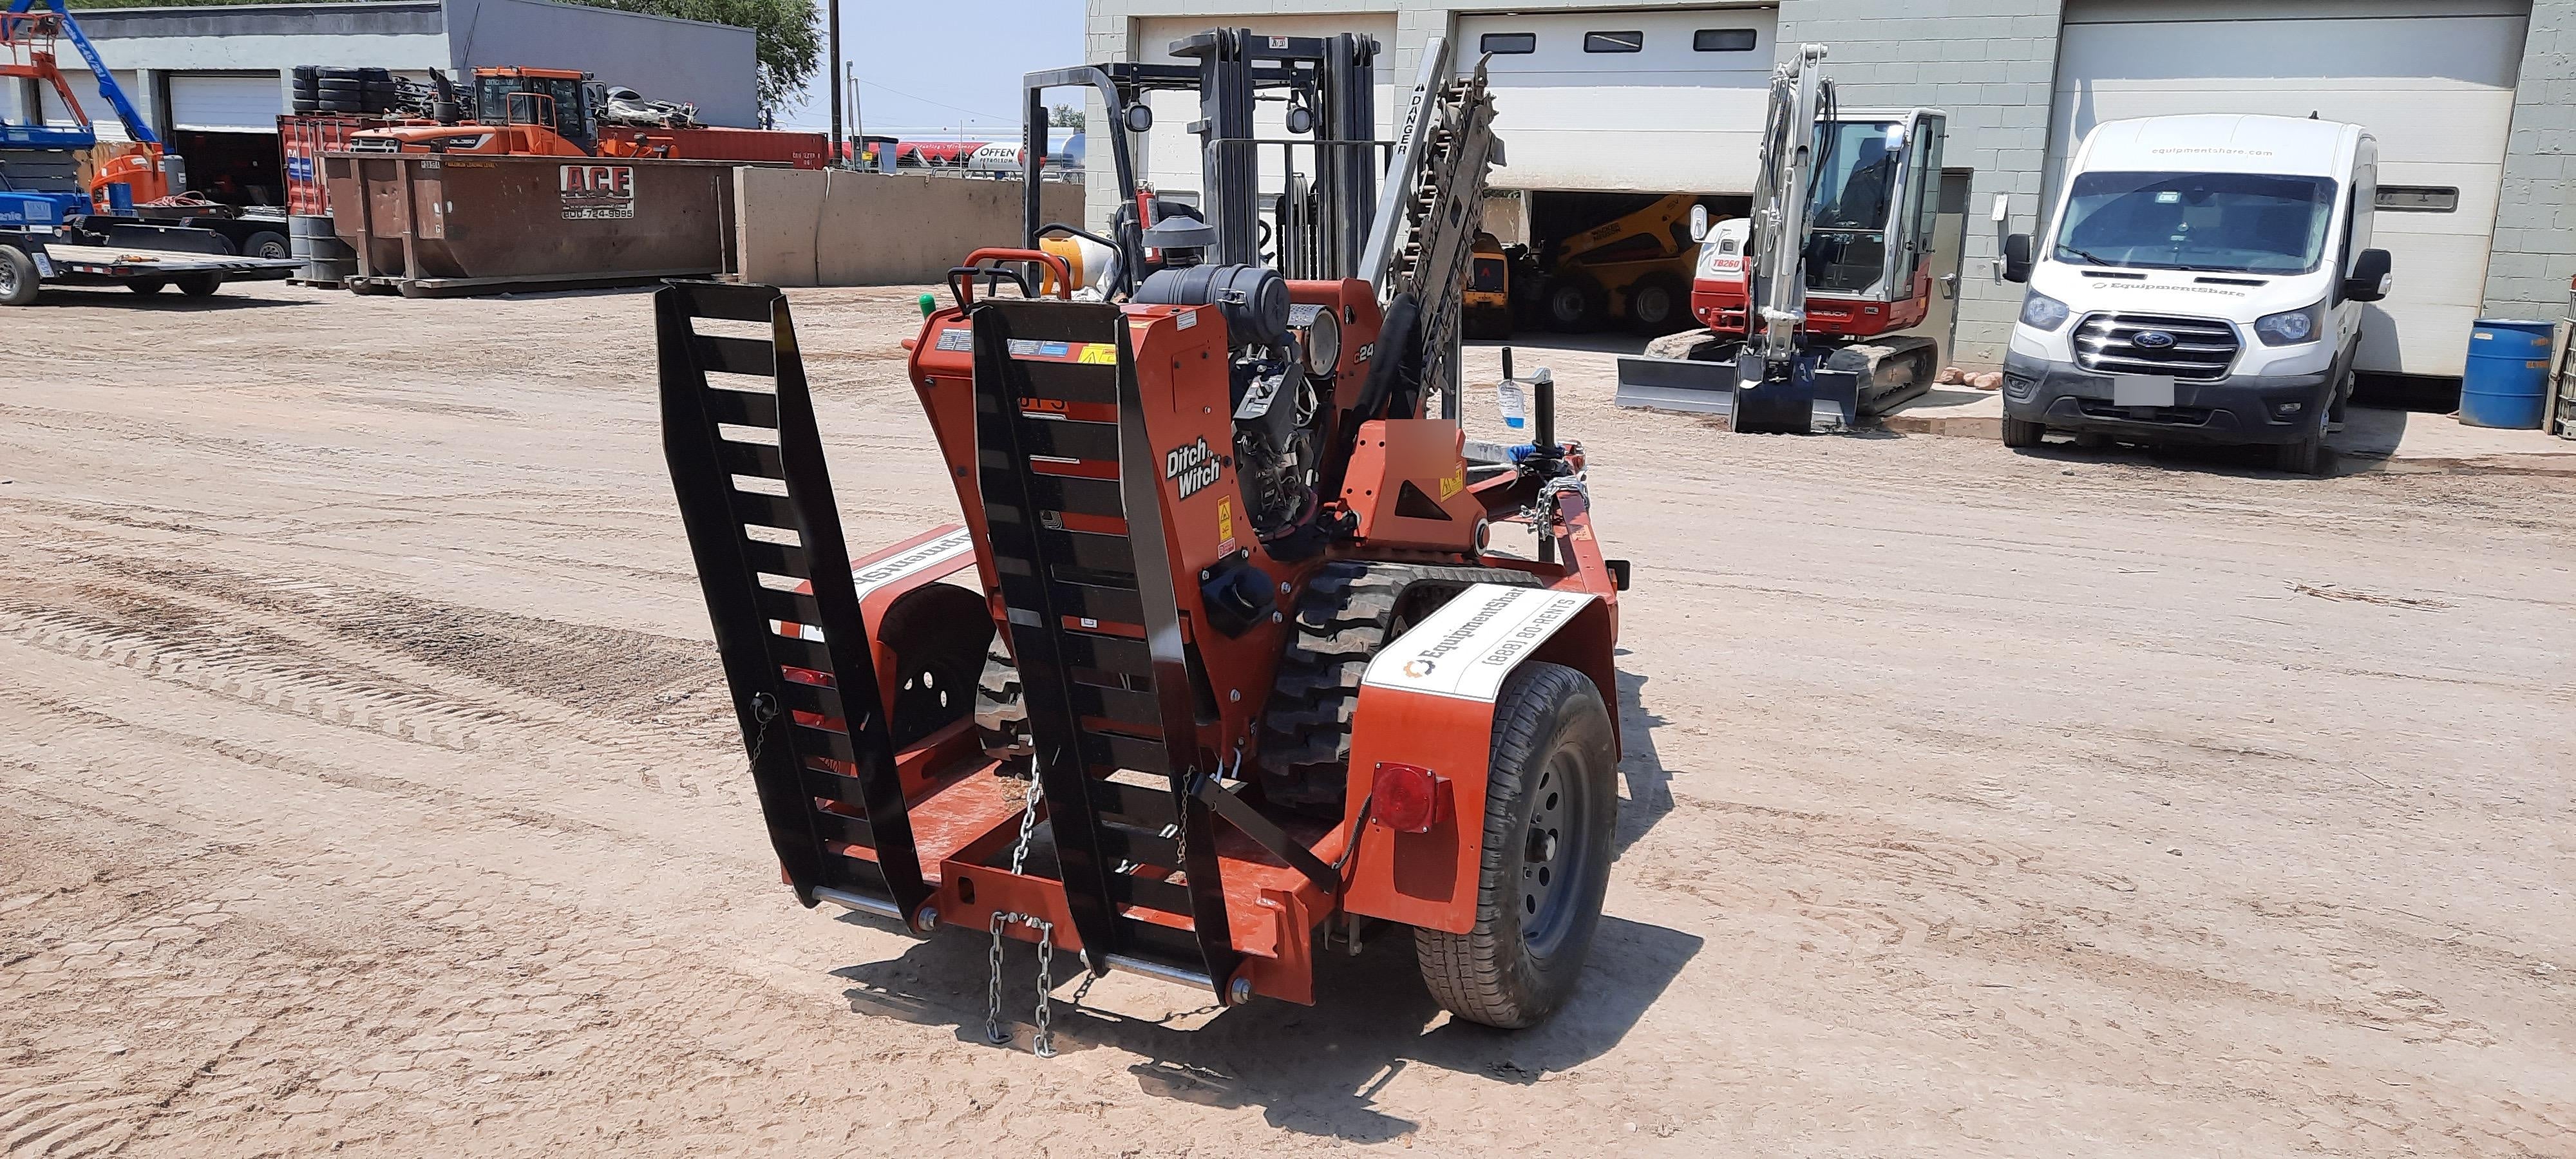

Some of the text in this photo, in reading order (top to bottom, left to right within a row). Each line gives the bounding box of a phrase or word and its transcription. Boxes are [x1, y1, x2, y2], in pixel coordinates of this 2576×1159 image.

[1397, 95, 1422, 155] DANGER
[980, 147, 1017, 156] OFFEN
[2151, 147, 2273, 156] equipmentshare.com
[566, 167, 630, 196] ACE
[1713, 259, 1740, 268] TB260
[2111, 282, 2246, 297] EquipmentShare
[2141, 334, 2166, 345] Ford
[1167, 437, 1207, 479] Ditch
[1179, 457, 1222, 499] Witch
[1482, 599, 1576, 666] (888) 80-RENTS
